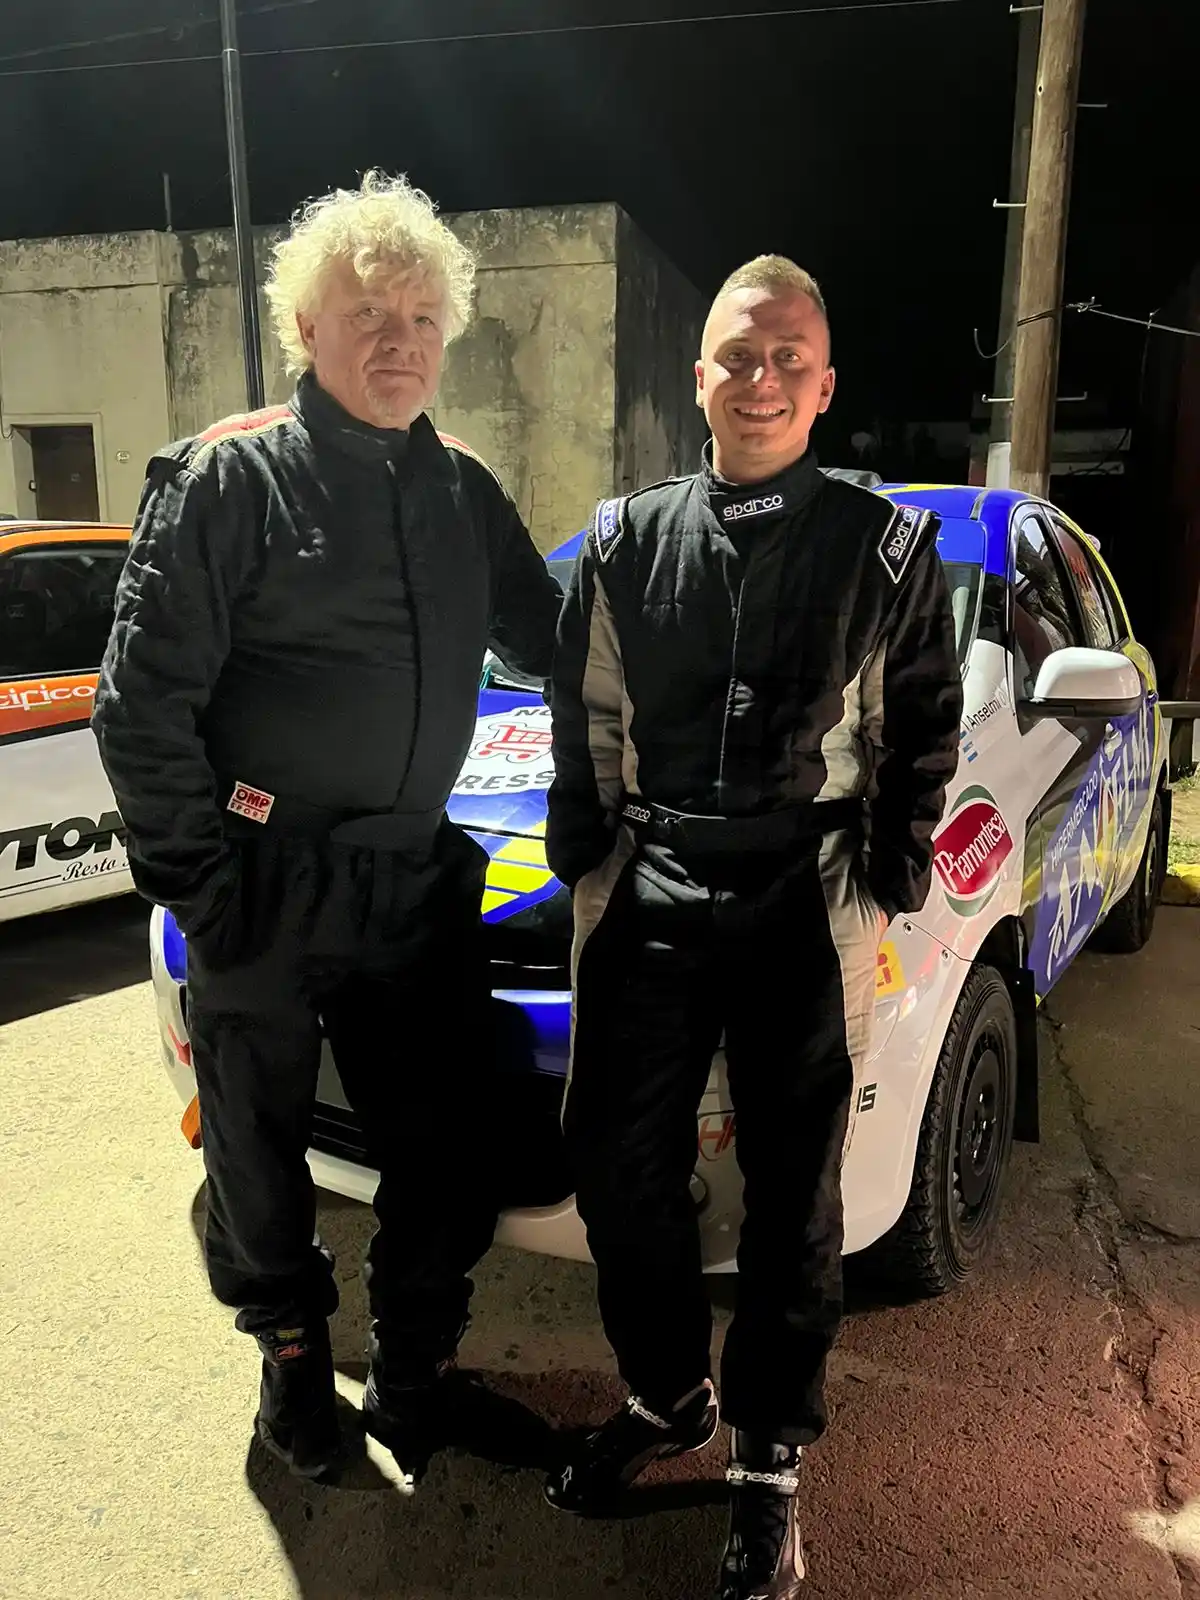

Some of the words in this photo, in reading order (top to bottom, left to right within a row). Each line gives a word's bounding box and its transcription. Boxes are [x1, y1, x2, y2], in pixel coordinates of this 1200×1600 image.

[723, 495, 783, 520] sparco
[236, 788, 270, 809] OMP
[934, 812, 1007, 893] Piamontesa
